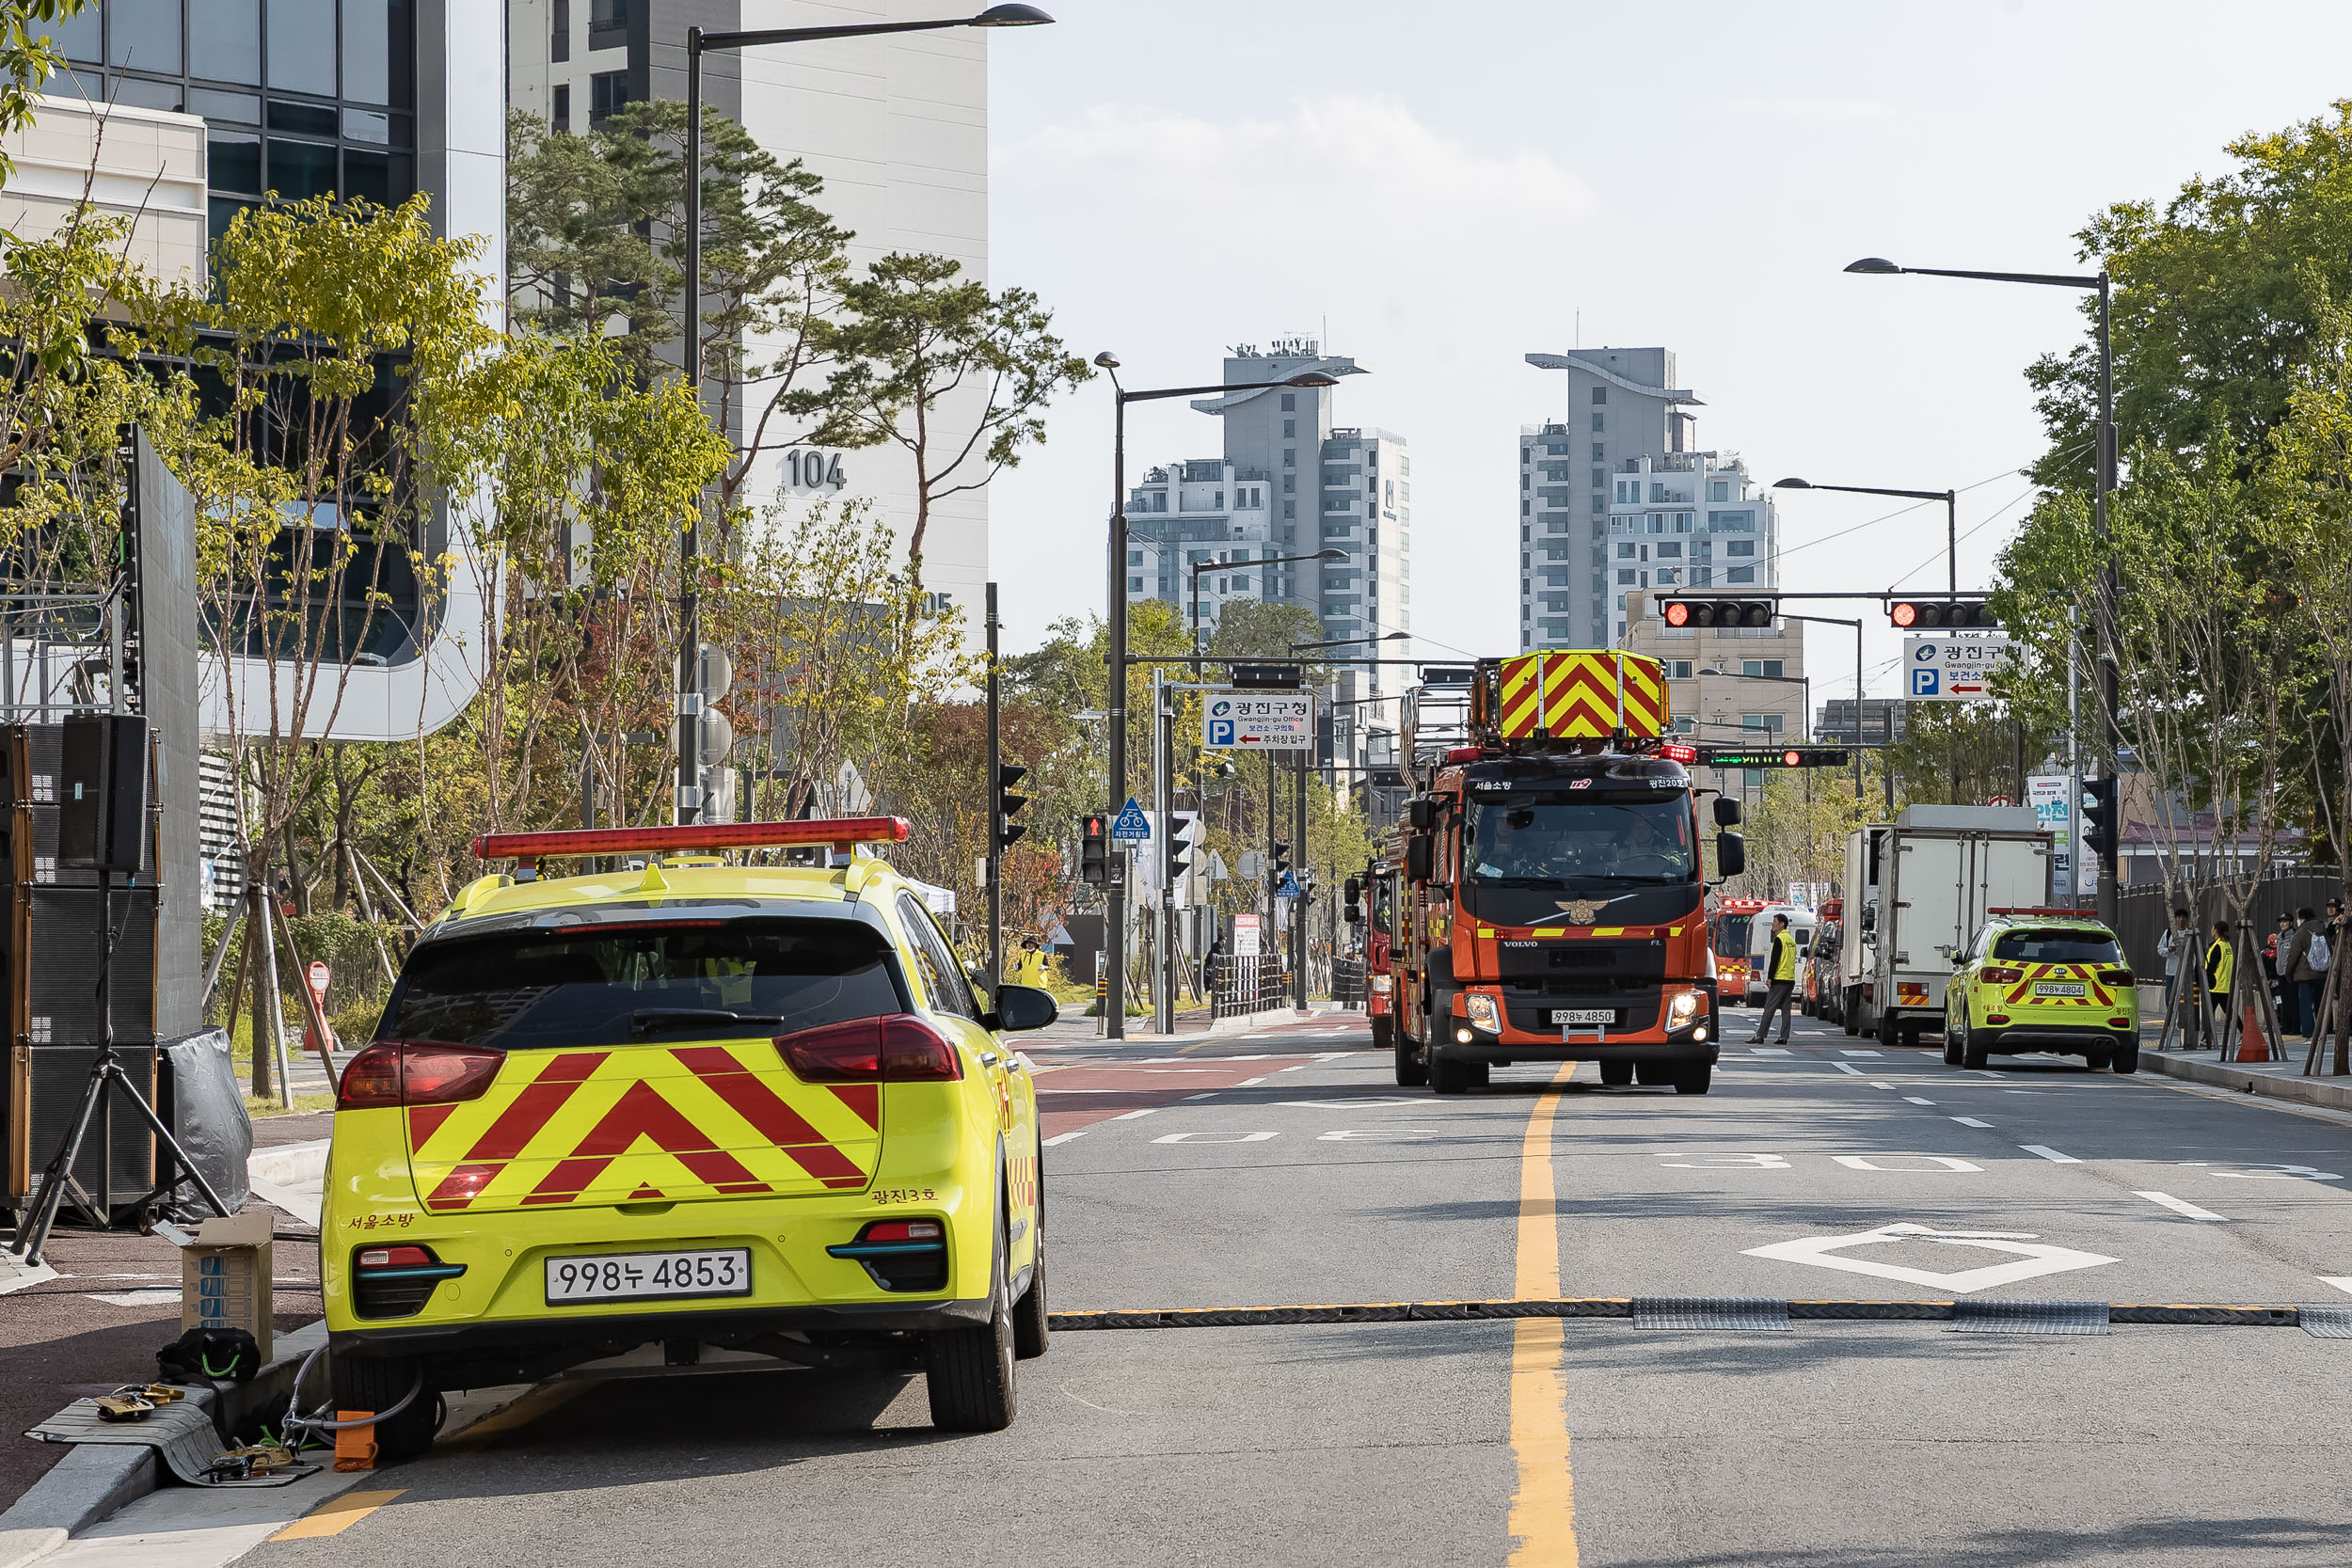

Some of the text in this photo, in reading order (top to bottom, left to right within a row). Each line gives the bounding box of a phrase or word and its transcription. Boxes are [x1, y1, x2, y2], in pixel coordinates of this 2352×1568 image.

[787, 449, 848, 490] 104
[1944, 661, 1995, 670] Gwangjin-gu
[1235, 702, 1308, 716] 광진구청
[1237, 715, 1282, 723] Gwangjin-gu
[1474, 781, 1512, 790] 서울소방
[1569, 778, 1593, 789] 119
[1648, 779, 1685, 788] 광진20호
[2034, 803, 2069, 822] 안전
[2060, 986, 2081, 994] 4804
[1555, 1011, 1612, 1022] 998누 4850
[871, 1188, 939, 1205] 광진3호
[347, 1212, 415, 1229] 서울소방
[559, 1256, 736, 1294] 998누 4853
